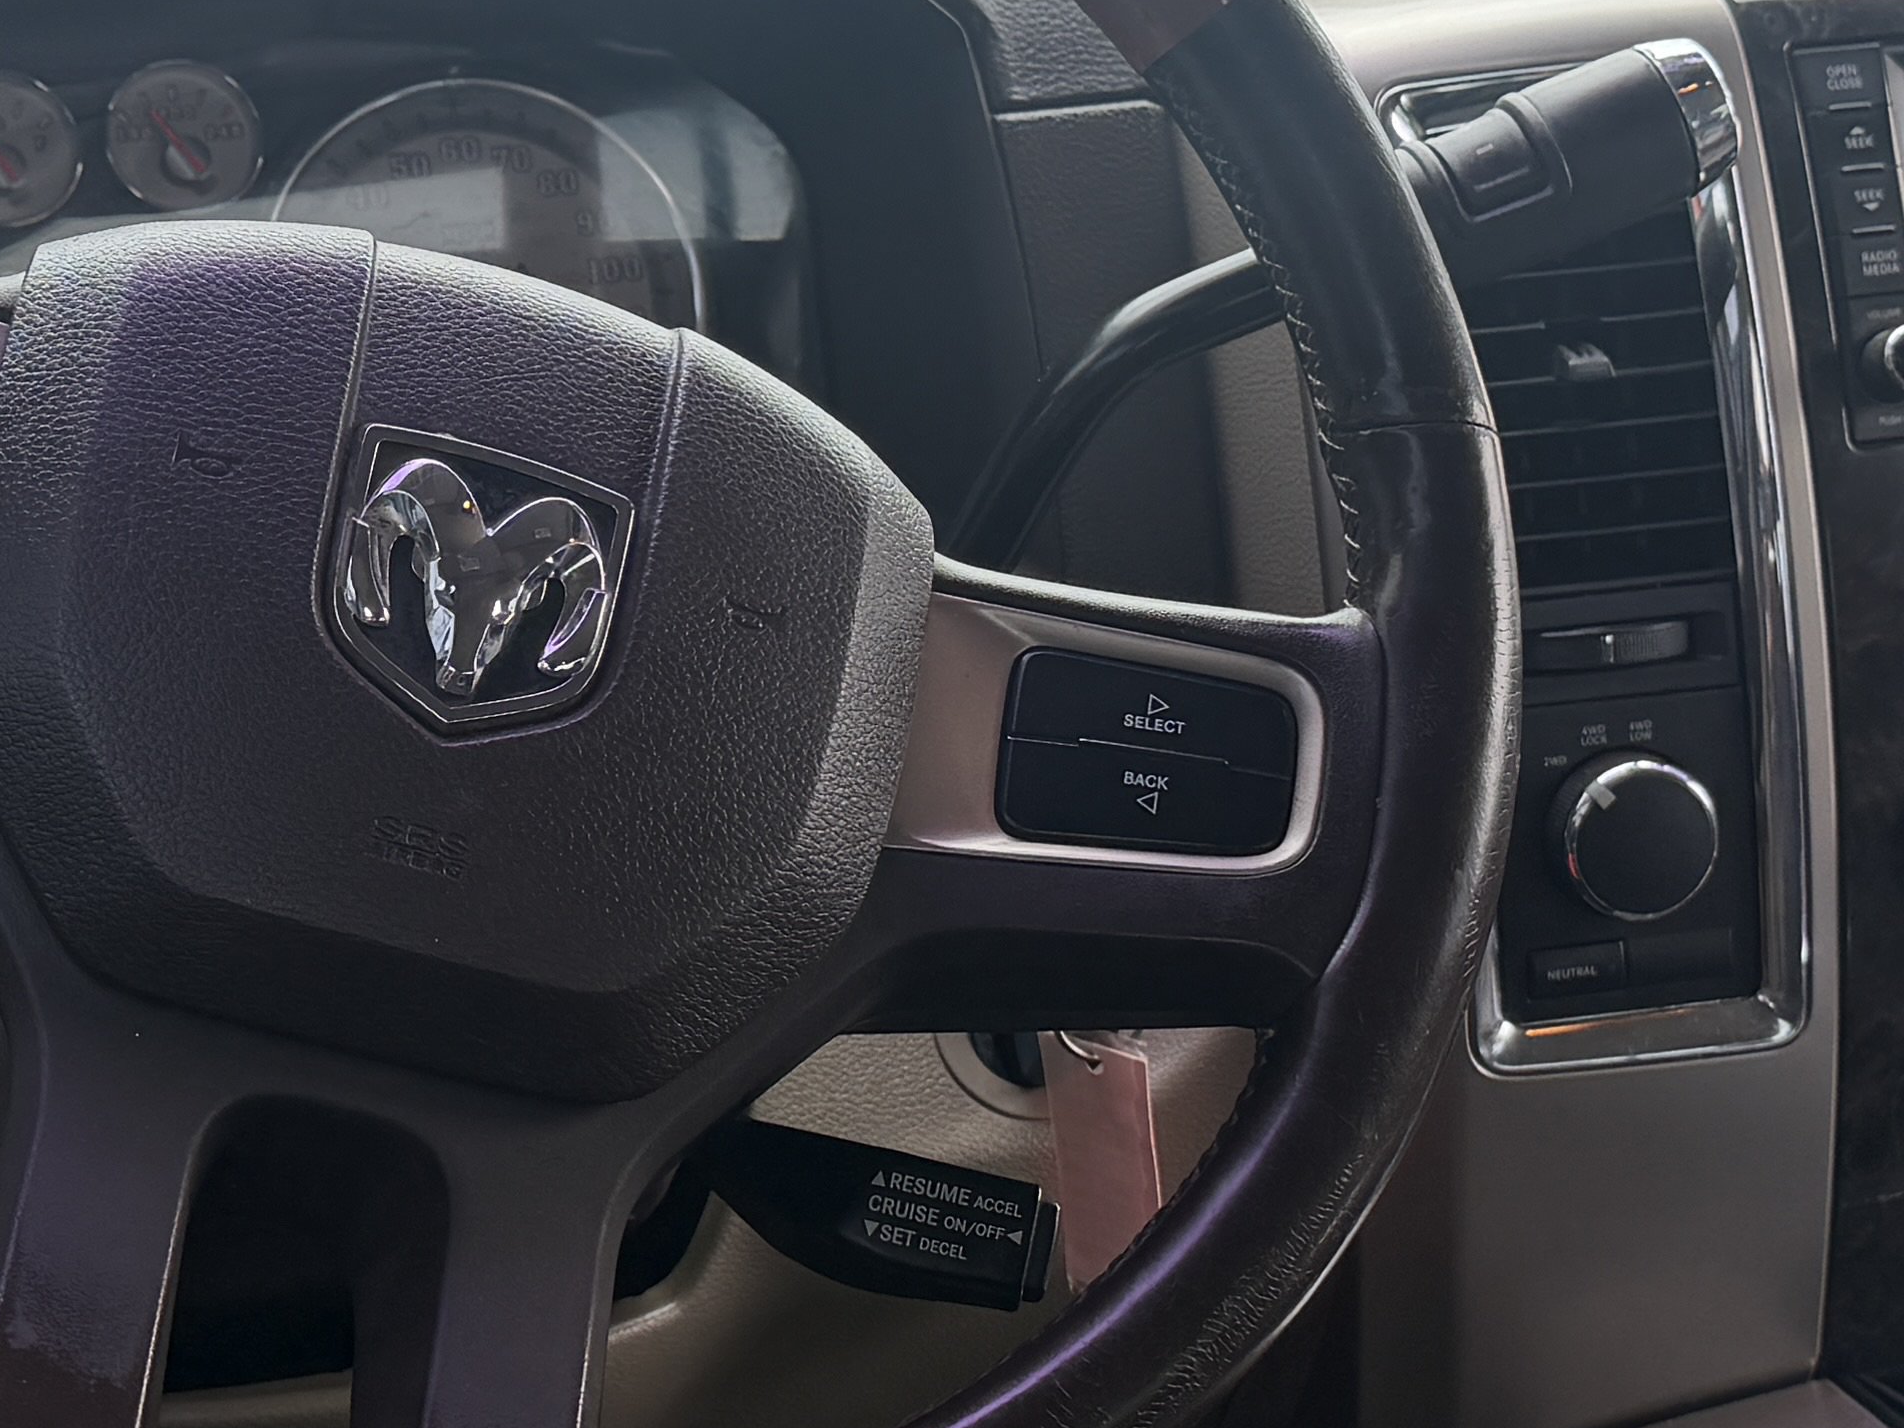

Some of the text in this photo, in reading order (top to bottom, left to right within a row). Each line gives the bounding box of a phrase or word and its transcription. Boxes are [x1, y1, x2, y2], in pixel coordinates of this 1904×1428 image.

[437, 134, 482, 163] 60
[1844, 133, 1875, 149] SEEK
[536, 170, 580, 197] 80
[1854, 188, 1884, 202] SEEK
[585, 255, 645, 285] 100
[1123, 714, 1186, 735] SELECT
[1581, 723, 1607, 736] 4WD
[1628, 718, 1653, 731] 4WD
[1581, 734, 1608, 746] LOCK
[1628, 730, 1653, 742] LOW
[1123, 771, 1170, 792] BACK
[1546, 965, 1598, 982] NEUTRAL
[889, 1171, 1023, 1219] RESUME ACCEL
[867, 1192, 1007, 1242] CRUISE ON/OFF
[879, 1223, 968, 1262] SET DECEL
